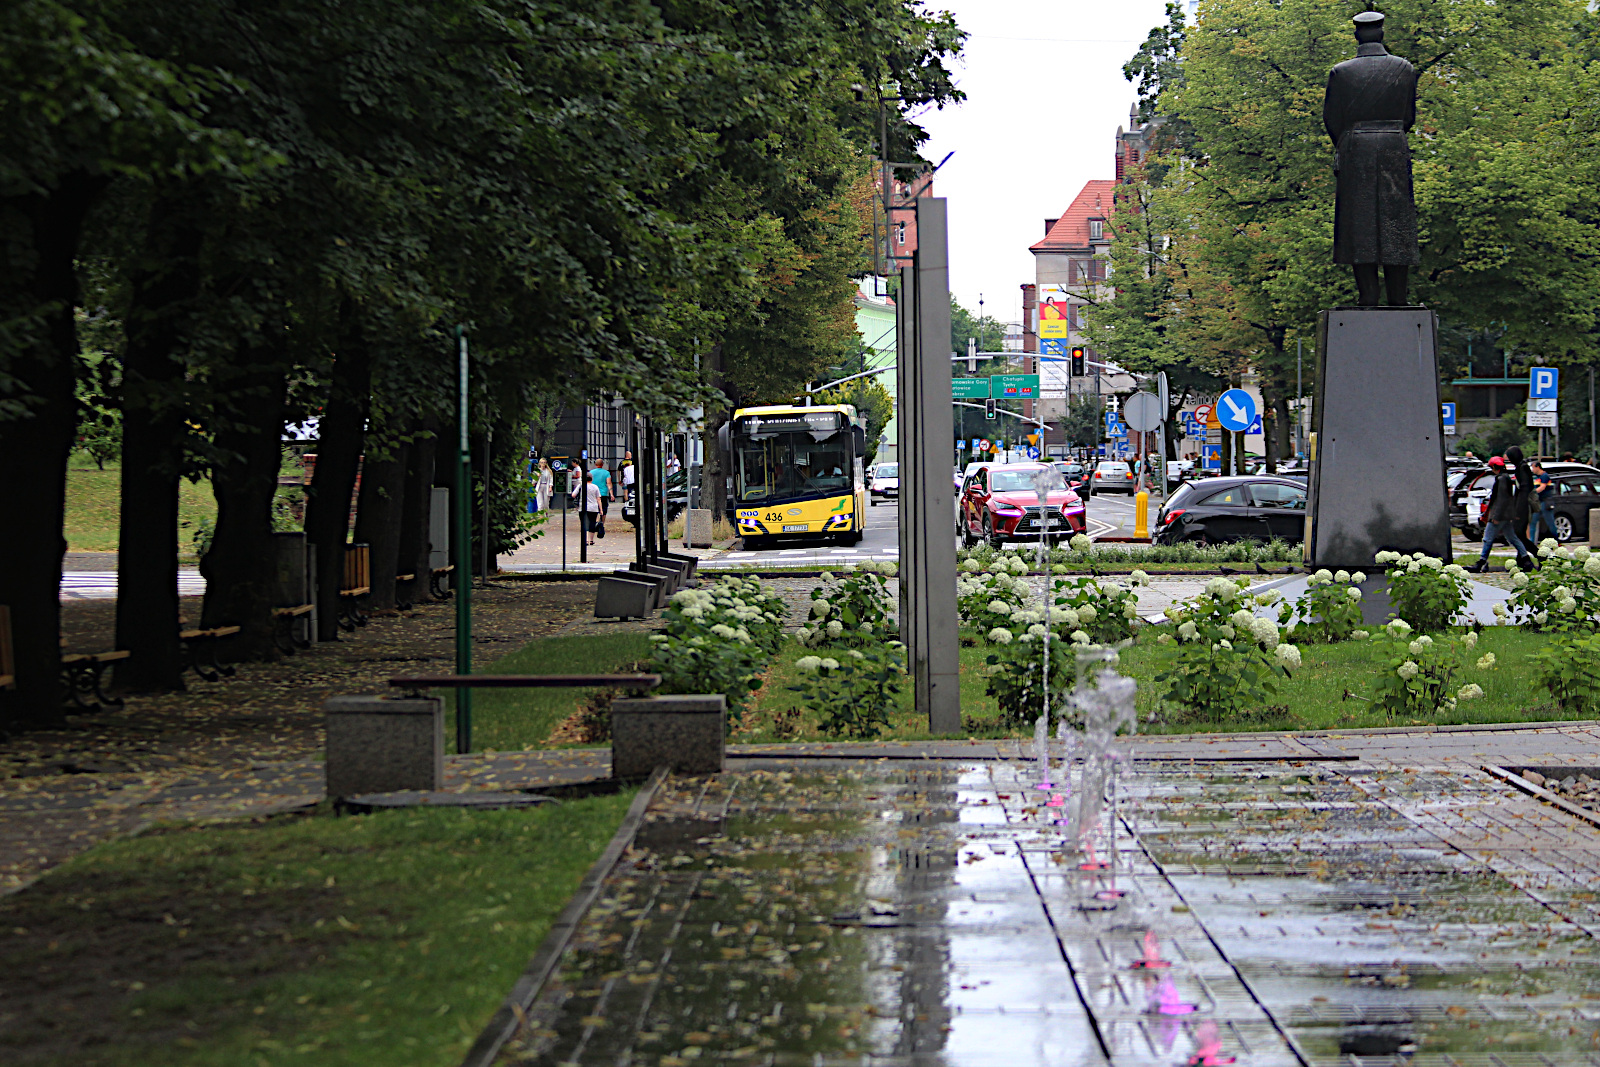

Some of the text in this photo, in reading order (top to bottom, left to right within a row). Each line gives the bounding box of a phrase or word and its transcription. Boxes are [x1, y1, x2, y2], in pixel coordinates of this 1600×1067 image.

[1536, 371, 1552, 395] P
[1108, 413, 1116, 424] P
[765, 512, 783, 522] 436
